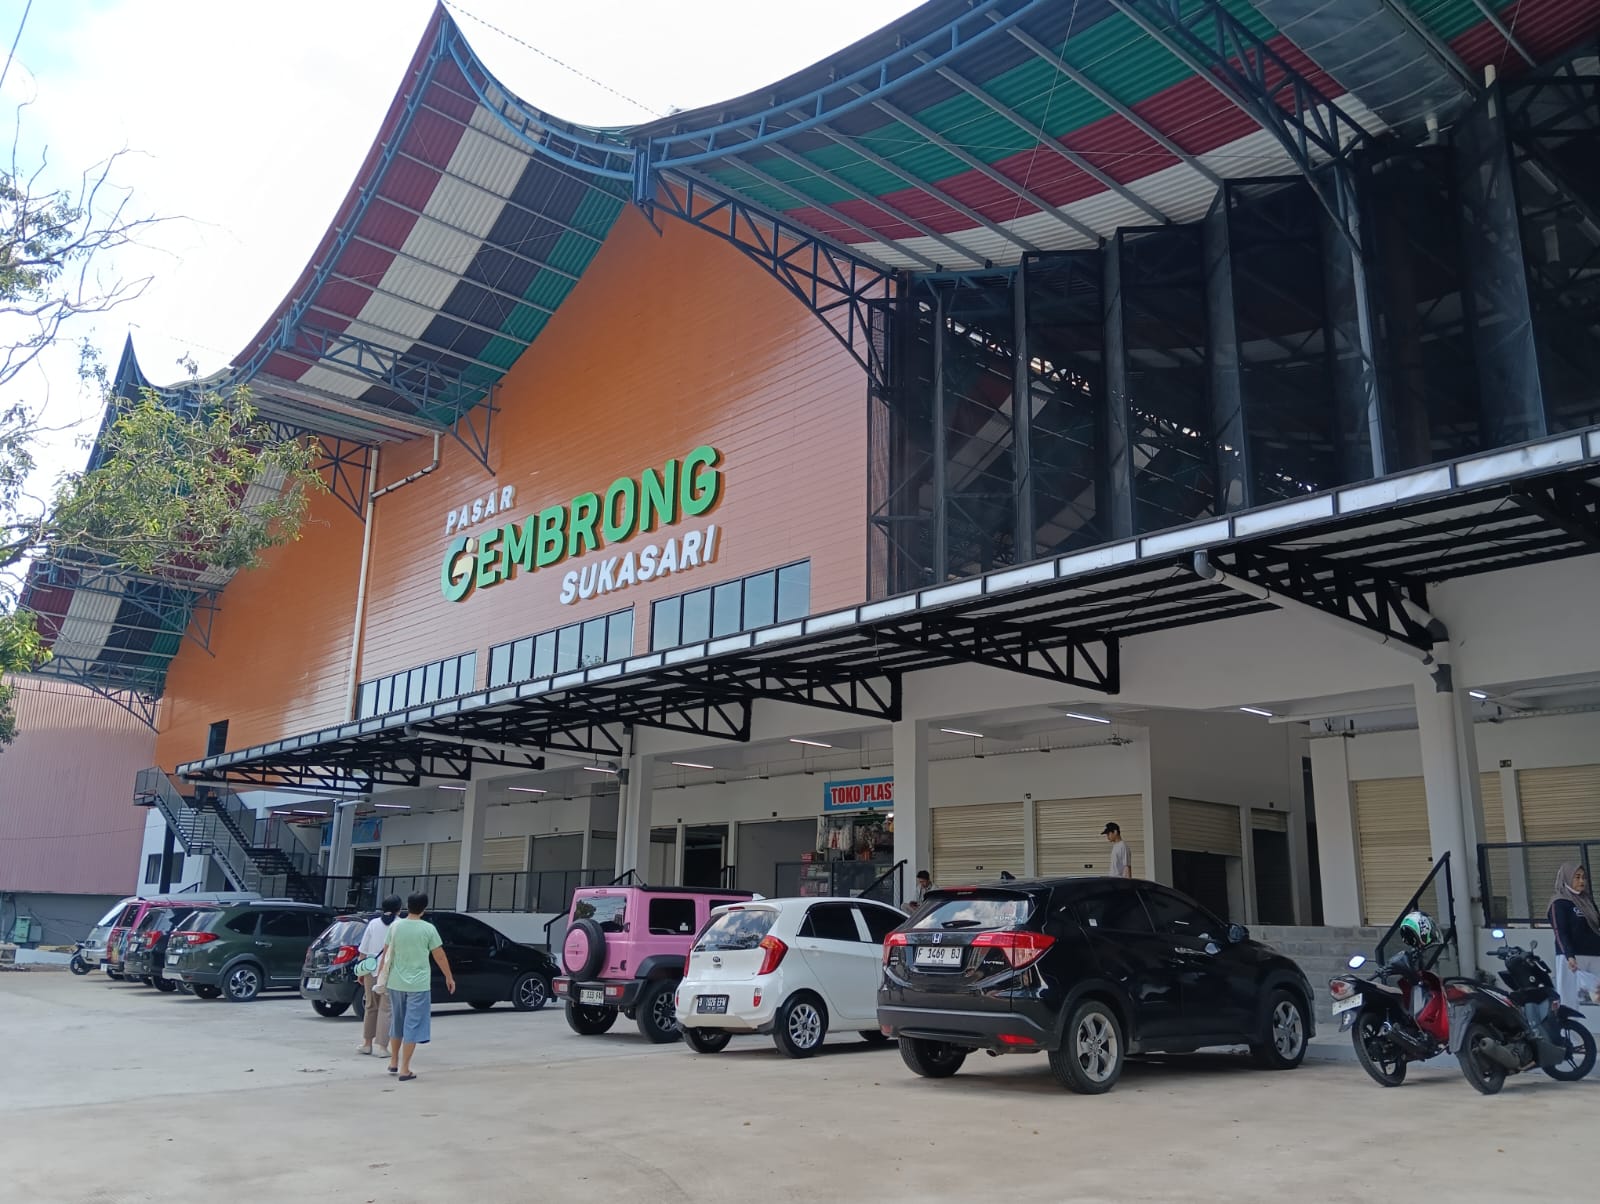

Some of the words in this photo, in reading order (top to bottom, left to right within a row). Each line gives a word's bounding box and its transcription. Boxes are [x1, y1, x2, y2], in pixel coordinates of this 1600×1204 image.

[440, 445, 720, 603] GEMBRONG
[445, 485, 516, 535] PASAR
[559, 524, 718, 605] SUKASARI
[831, 786, 861, 804] TOKO
[863, 782, 894, 802] PLAS
